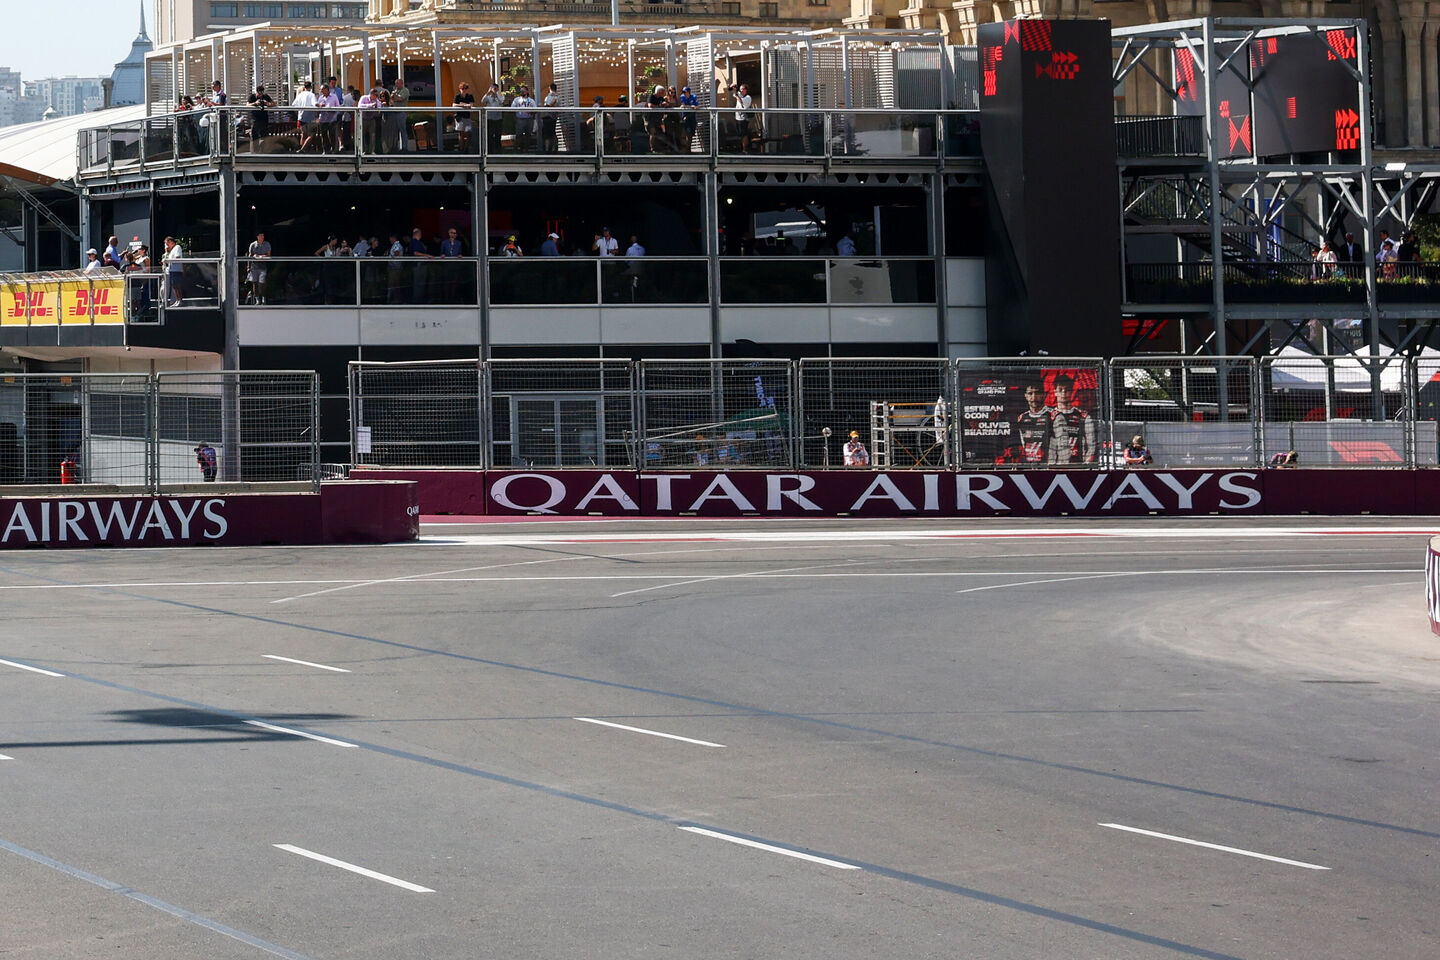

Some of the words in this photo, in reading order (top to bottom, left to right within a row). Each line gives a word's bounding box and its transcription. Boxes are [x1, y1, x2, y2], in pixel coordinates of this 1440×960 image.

[14, 291, 48, 318] DHL
[76, 288, 112, 316] DHL
[490, 474, 824, 514] QATAR
[850, 472, 1262, 511] AIRWAYS
[1, 499, 228, 542] AIRWAYS
